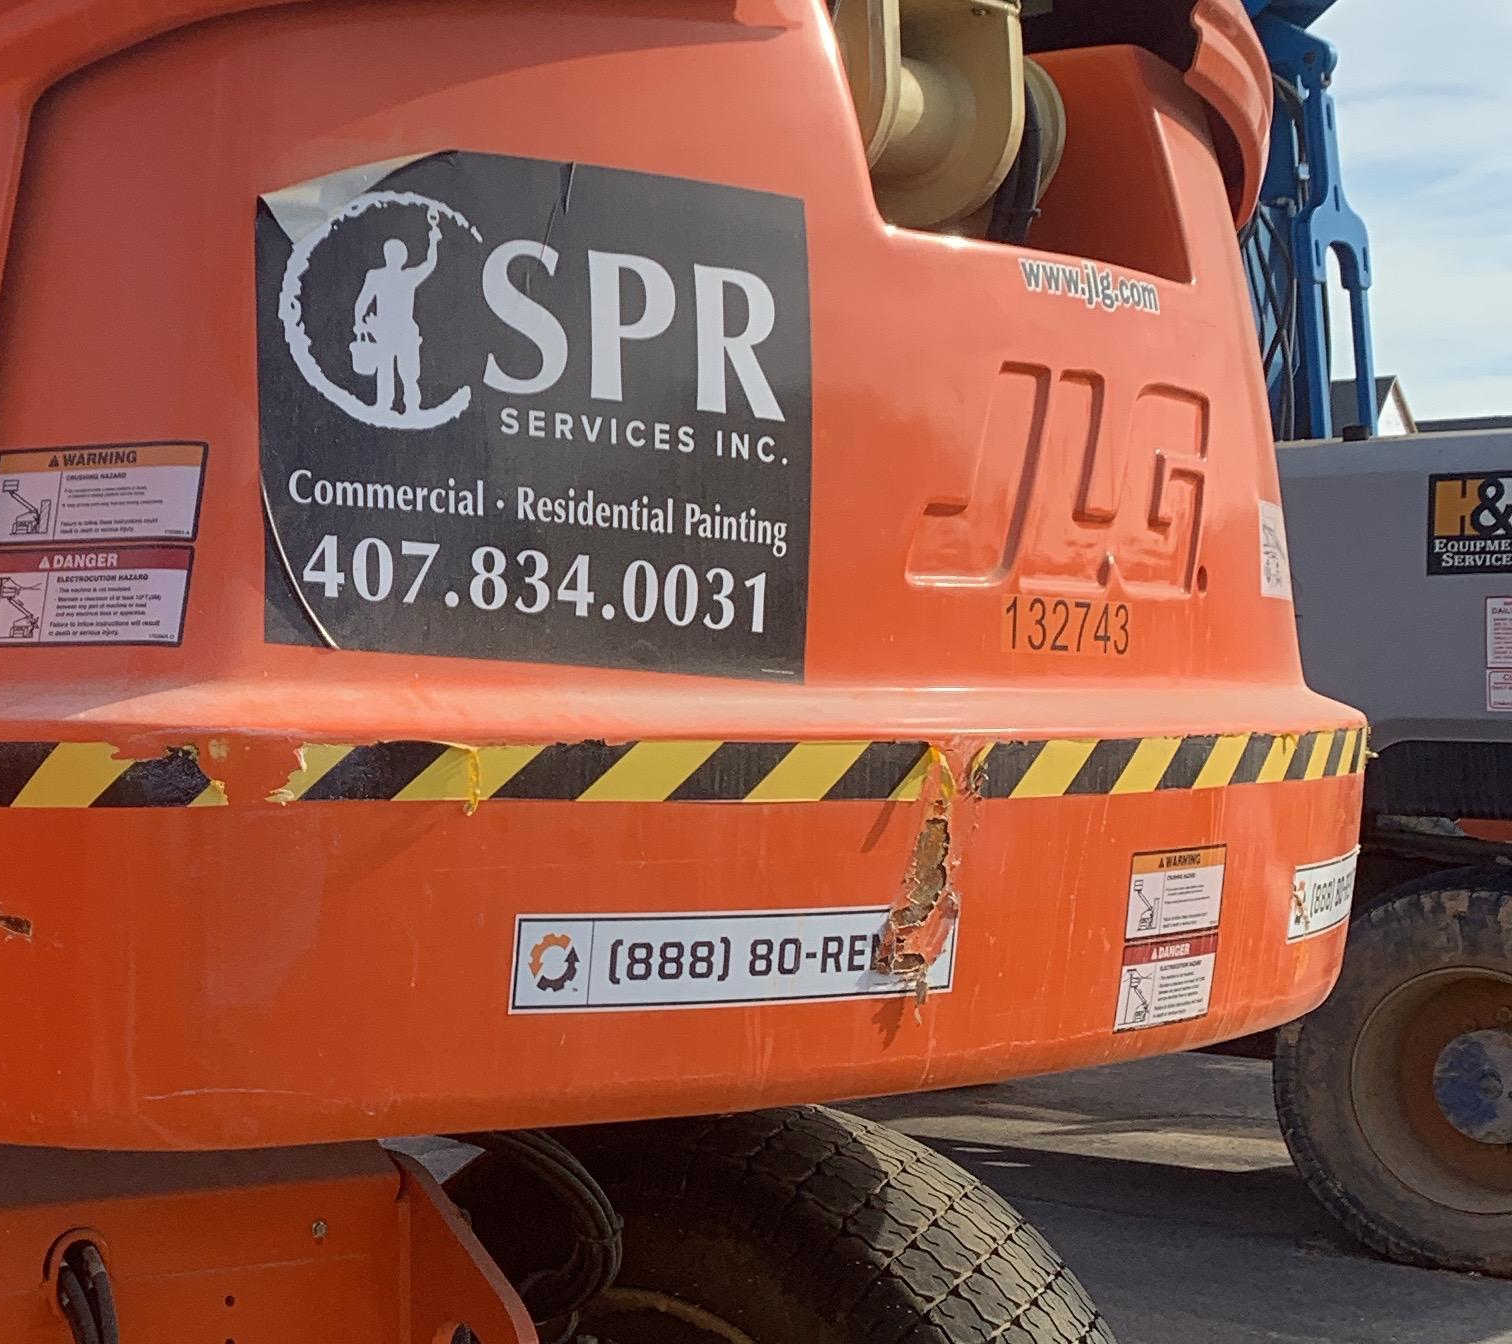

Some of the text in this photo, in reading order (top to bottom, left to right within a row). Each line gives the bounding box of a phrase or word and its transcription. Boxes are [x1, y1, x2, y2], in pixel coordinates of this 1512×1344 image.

[1019, 259, 1160, 313] www.jlg.com
[482, 239, 786, 422] SPR
[63, 451, 137, 466] WARNING
[499, 407, 789, 466] SERVICES INC.
[288, 469, 788, 557] Commercial Residential Painting
[53, 553, 118, 568] DANGER
[1433, 539, 1512, 553] EQUIPME
[56, 573, 149, 583] ELECTROCUTION HAZARD
[302, 534, 769, 635] 407.834.0031
[1005, 596, 1131, 655] 132743
[1166, 853, 1201, 868] WARNING
[1310, 878, 1335, 918] (888)
[608, 936, 732, 985] (888)
[1158, 942, 1191, 959] DANGER
